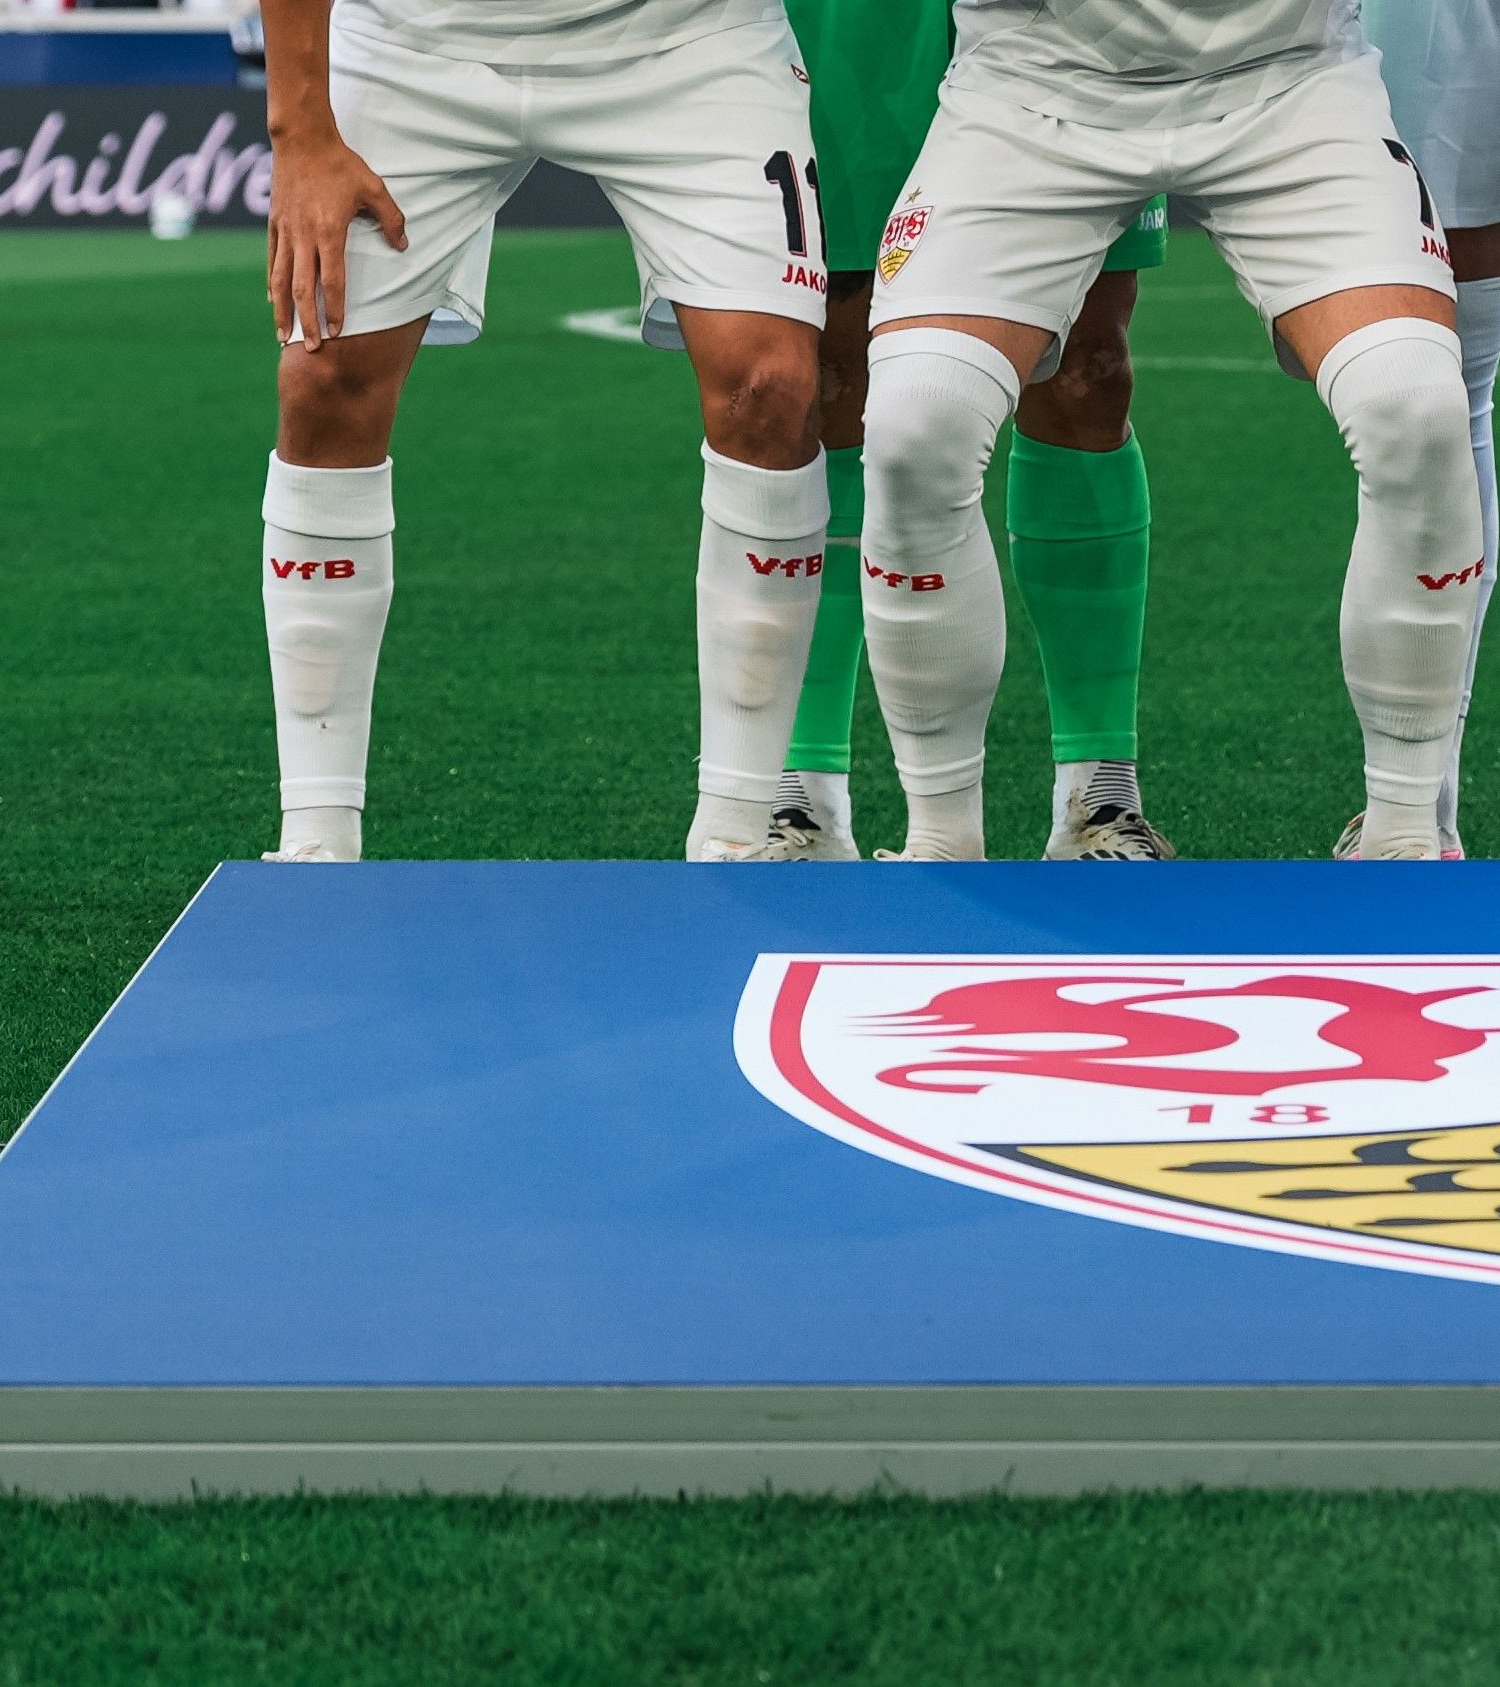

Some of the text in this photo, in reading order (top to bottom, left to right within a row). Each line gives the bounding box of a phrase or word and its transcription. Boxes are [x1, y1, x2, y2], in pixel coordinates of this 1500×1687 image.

[270, 557, 356, 580] VfB
[746, 551, 823, 578] VfB
[863, 554, 946, 593] VfB
[1158, 1102, 1331, 1126] 18
